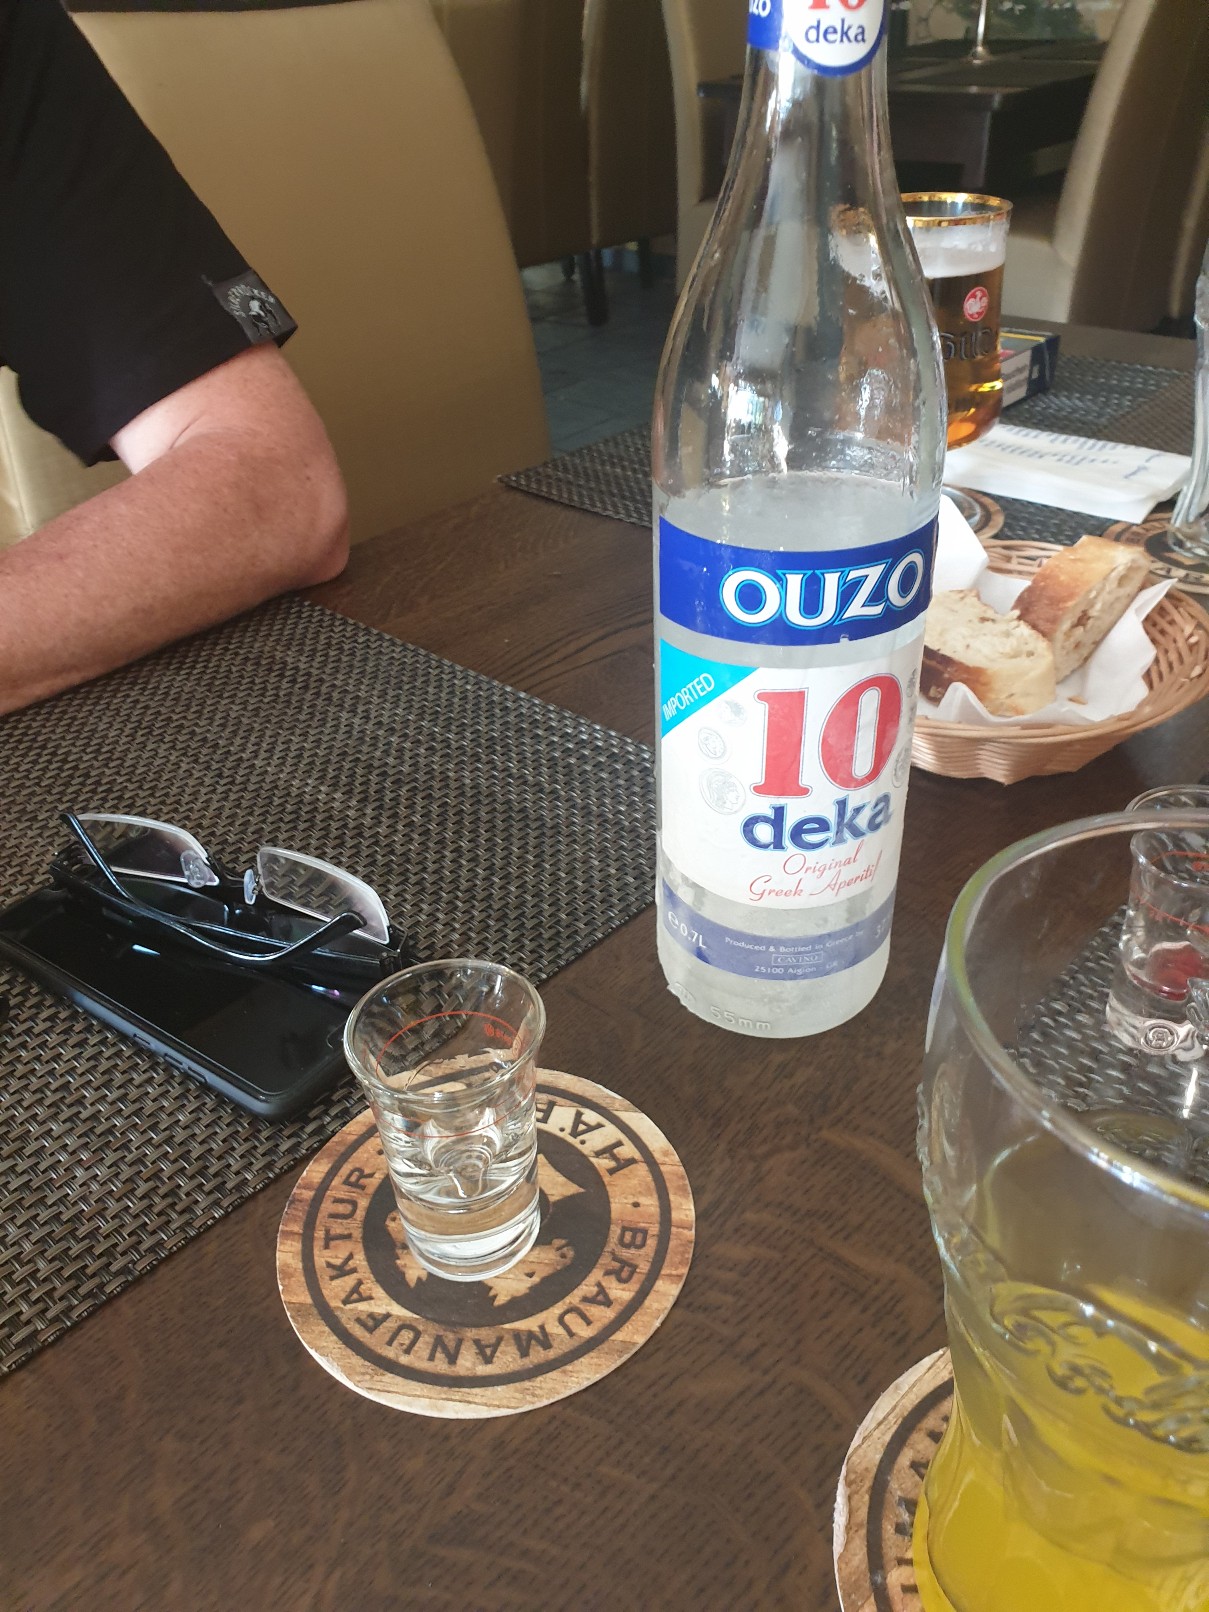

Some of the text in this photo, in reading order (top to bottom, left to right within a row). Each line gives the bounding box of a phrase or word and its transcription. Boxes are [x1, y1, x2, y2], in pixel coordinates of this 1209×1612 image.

[804, 18, 866, 44] deka
[719, 549, 925, 630] OUZO
[662, 672, 715, 721] IMPORTED
[750, 673, 904, 798] 10
[740, 792, 895, 851] deka
[749, 850, 882, 901] Greek Aperitif
[783, 839, 864, 879] Original
[724, 936, 766, 951] Produced
[779, 944, 812, 953] Bottled
[754, 965, 784, 974] 25100
[787, 965, 817, 975] Aigion
[710, 1005, 771, 1031] 55mm
[324, 1166, 649, 1365] BRAUMANUFAKTUR
